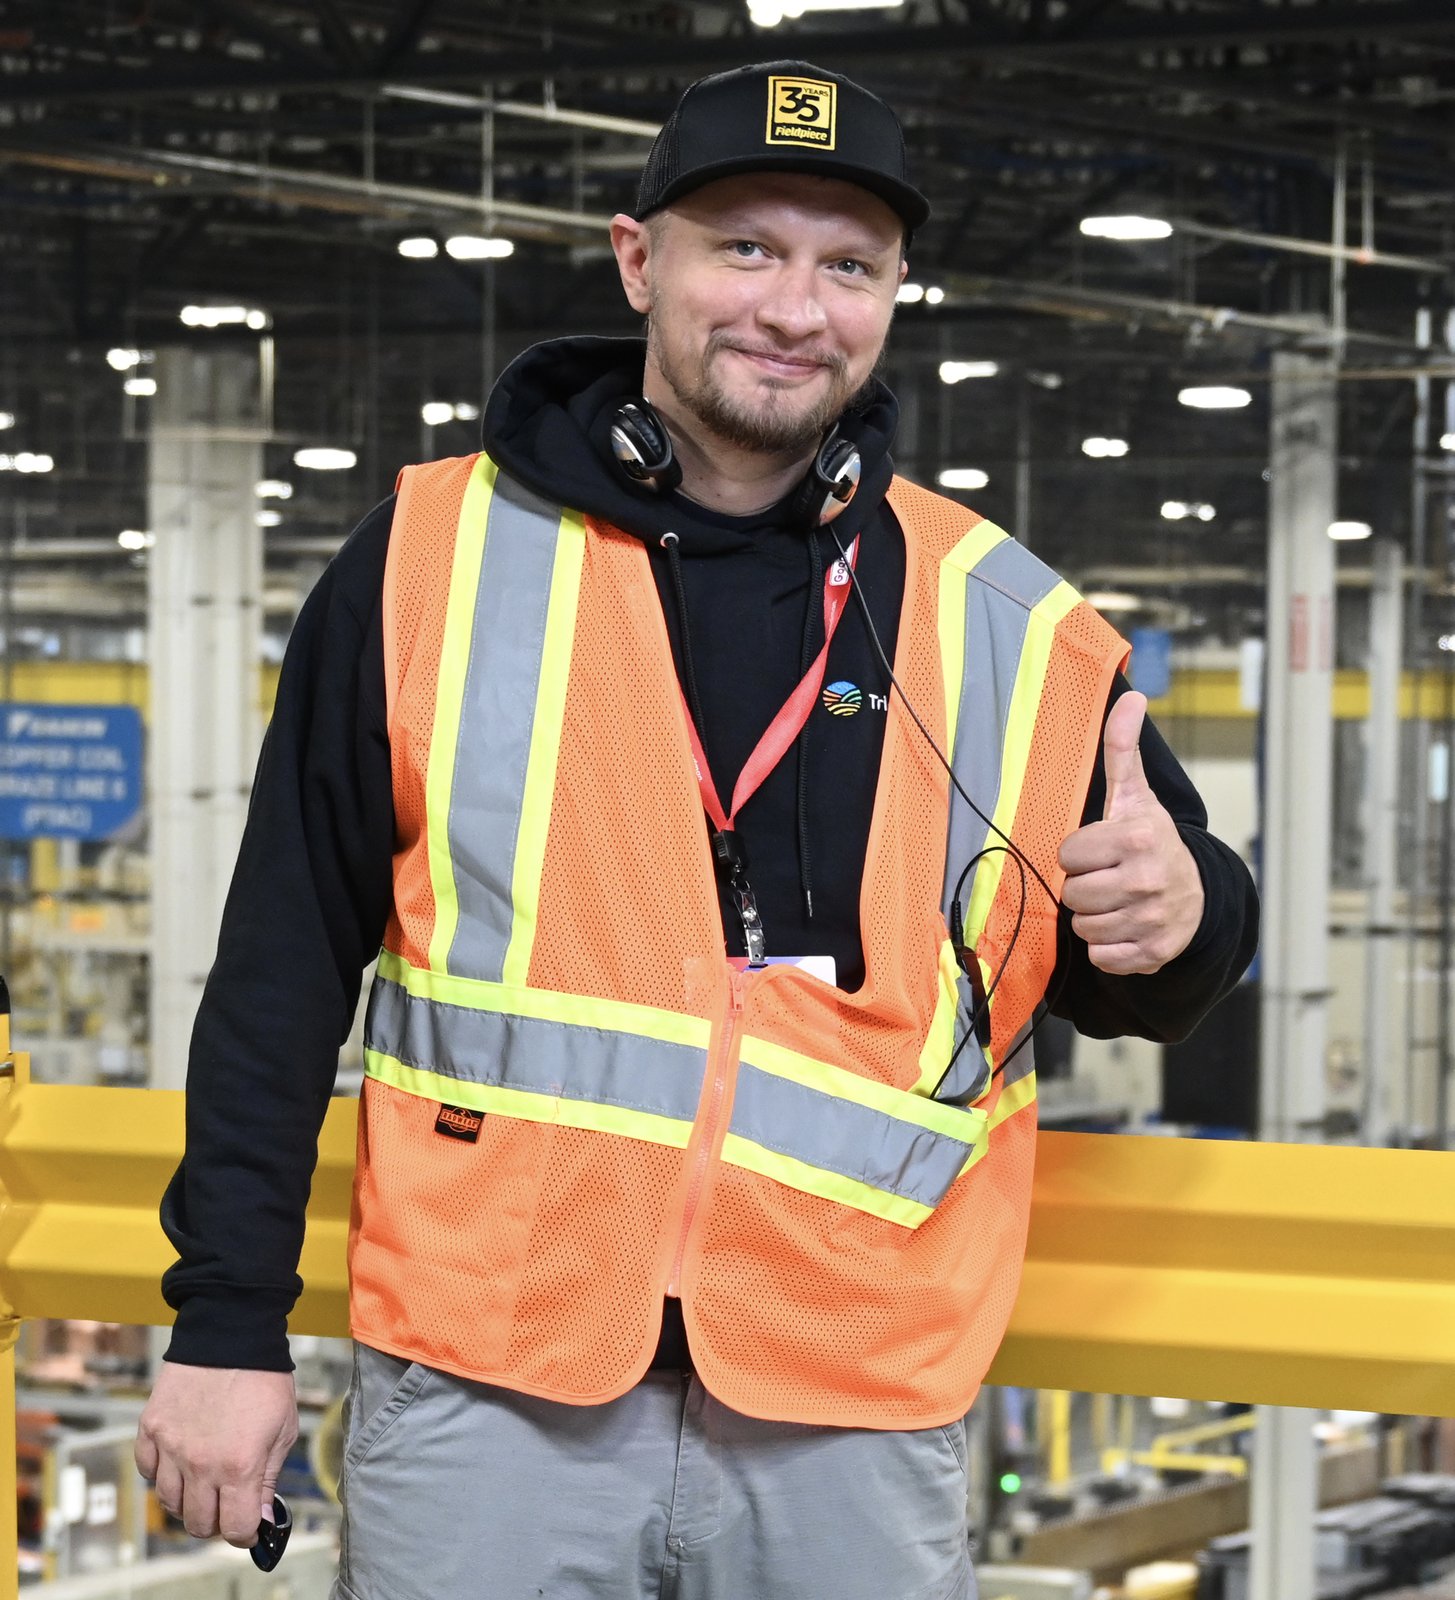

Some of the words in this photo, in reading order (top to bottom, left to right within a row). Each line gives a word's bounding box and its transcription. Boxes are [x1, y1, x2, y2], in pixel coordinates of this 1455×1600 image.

[779, 87, 820, 122] 35
[804, 88, 829, 97] YEARS
[775, 126, 828, 141] Fieldpiece
